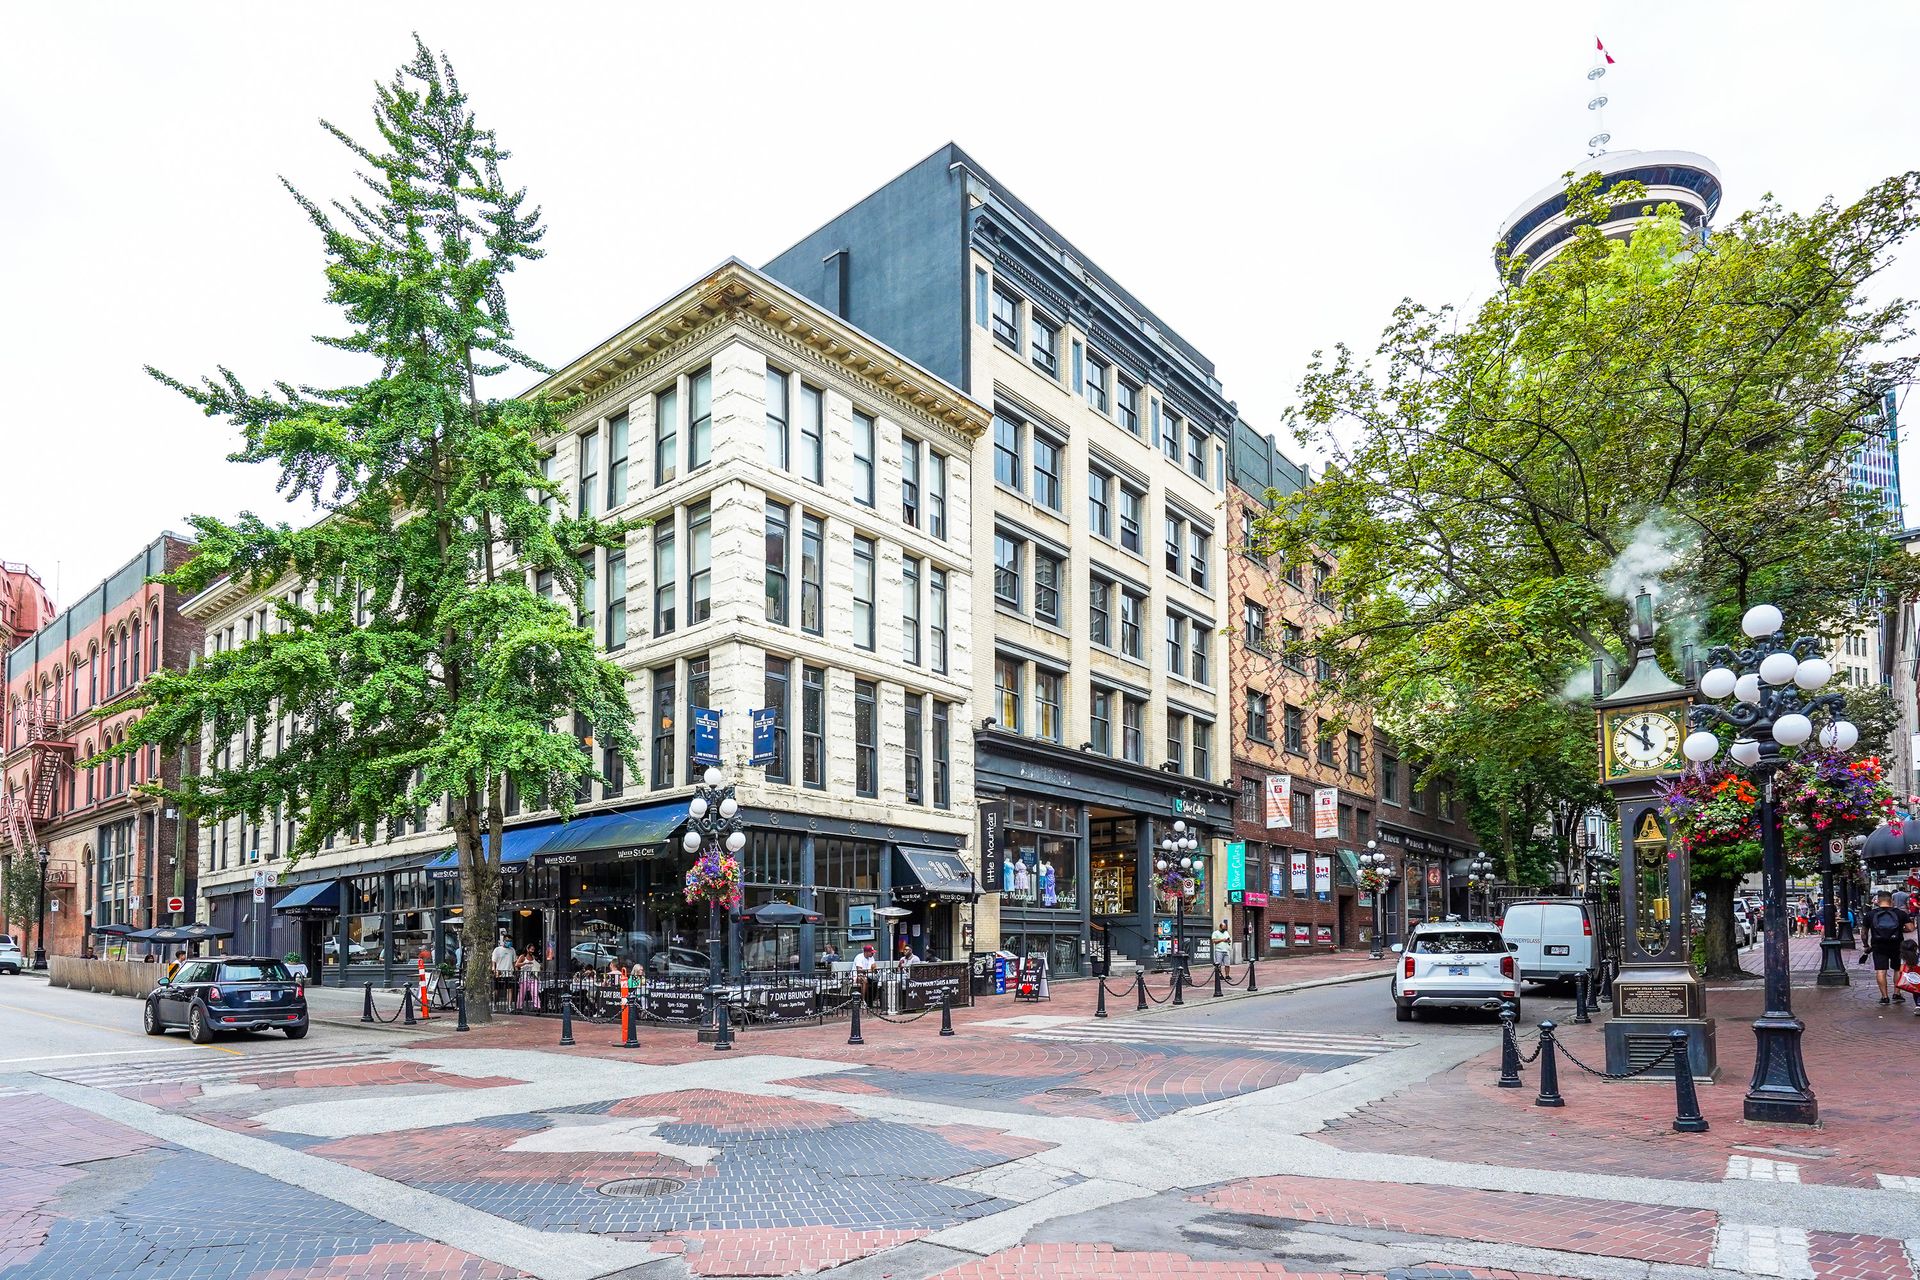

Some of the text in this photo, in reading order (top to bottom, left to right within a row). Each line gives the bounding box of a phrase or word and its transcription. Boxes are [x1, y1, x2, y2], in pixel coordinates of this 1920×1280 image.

[987, 812, 996, 858] Mountain
[617, 850, 632, 859] WATER
[1022, 974, 1037, 982] LIVE
[769, 993, 775, 1001] 7
[774, 992, 788, 1001] DAY
